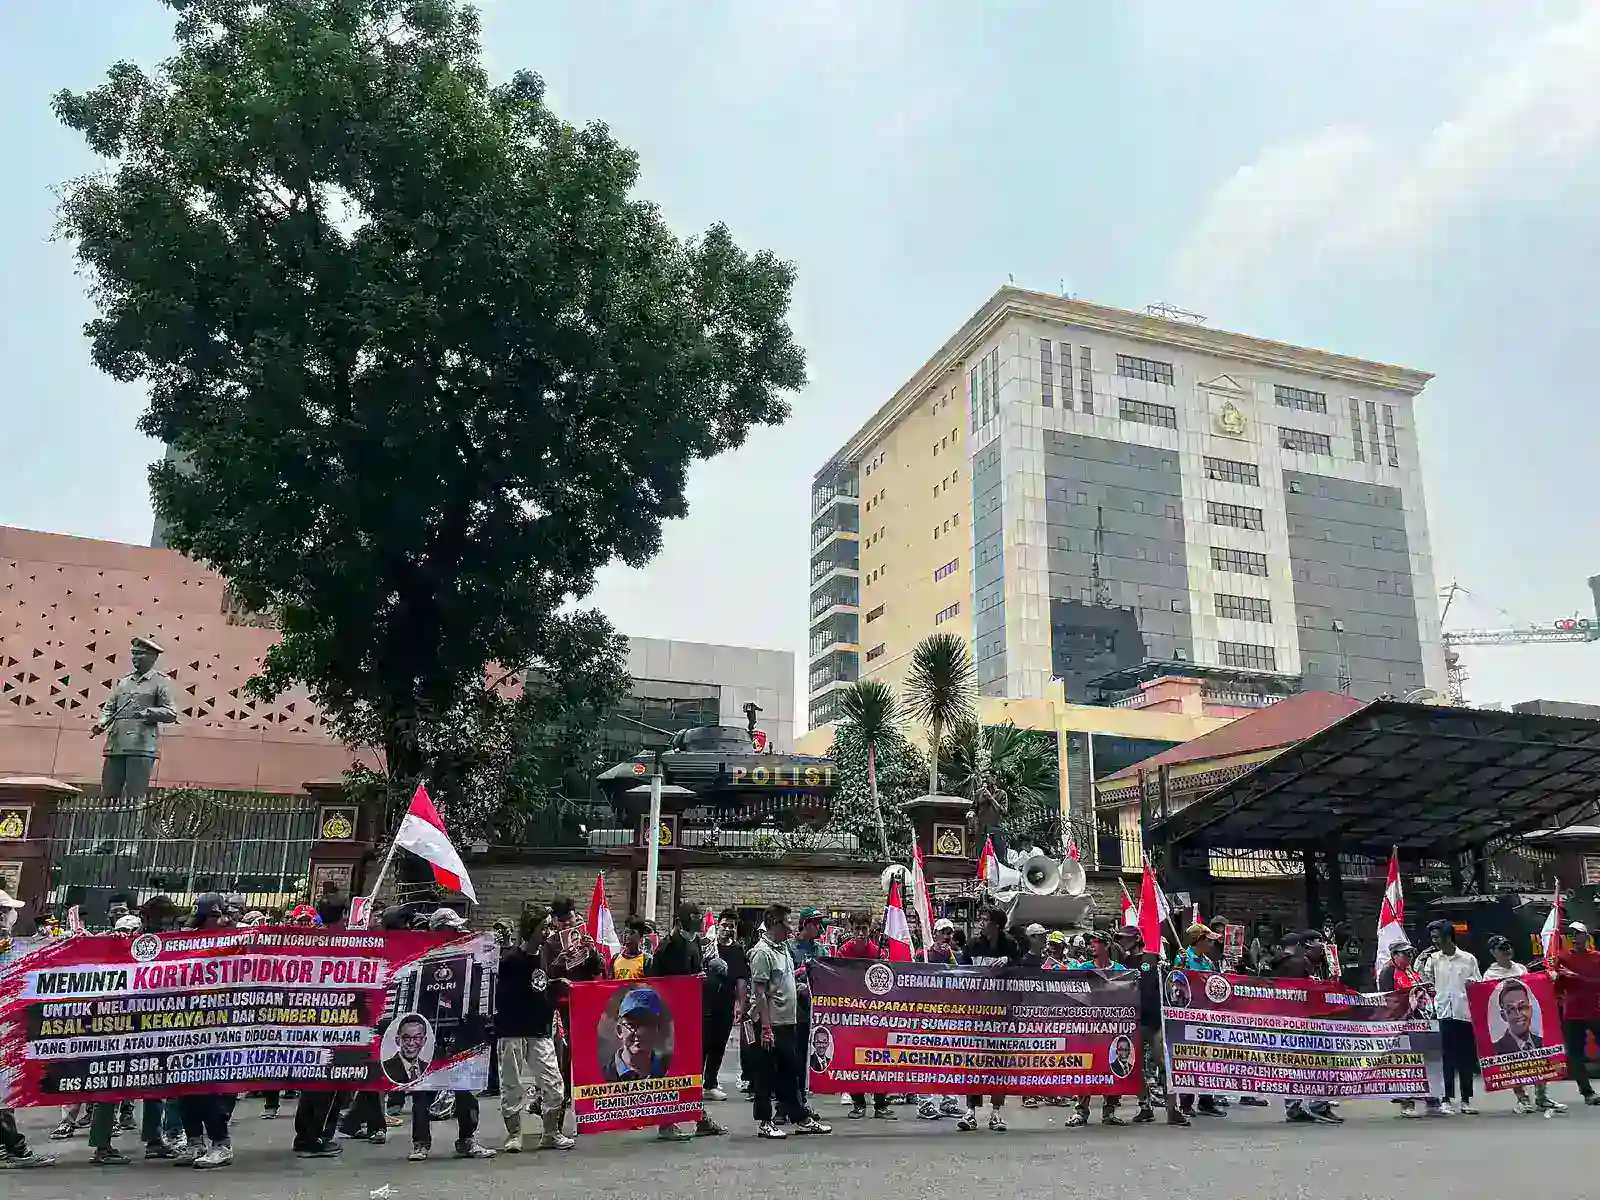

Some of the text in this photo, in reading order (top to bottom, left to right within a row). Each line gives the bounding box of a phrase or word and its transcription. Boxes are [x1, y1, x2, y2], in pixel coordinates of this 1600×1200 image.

[732, 766, 832, 786] POLISI
[165, 937, 214, 951] GERAKAN
[216, 933, 256, 948] RAKYAT
[257, 933, 282, 947] ANTI
[283, 934, 329, 947] KORUPSI
[330, 935, 385, 948] INDONESIA
[36, 958, 379, 994] MEMINTA KORTASTIPIDKOR POLRI
[897, 974, 1092, 994] GERAKAN RAKYAT ANTI KORUPSI INDONESIA
[426, 982, 457, 992] POLRI
[42, 992, 356, 1018] UNTUK MELAKUKAN PENELUSURAN TERHADAP
[868, 999, 916, 1013] APARAT
[917, 1002, 967, 1014] PENEGAK
[968, 1003, 1007, 1016] HUKUM
[1012, 1005, 1048, 1018] UNTUK
[1099, 1006, 1136, 1018] TUNTAS
[40, 1008, 359, 1036] ASAL-USUL KEKAYAAN DAN SUMBER DANA
[842, 1013, 920, 1030] MENGAUDIT
[921, 1018, 973, 1032] SUMBER
[974, 1020, 1016, 1034] HARTA
[1017, 1021, 1044, 1033] DAN
[1044, 1022, 1118, 1034] KEPEMILIKAN
[1118, 1022, 1137, 1034] IUP
[1163, 1008, 1208, 1021] MENDESAK
[1210, 1012, 1283, 1028] KORTASTIPIDKOR
[1283, 1019, 1308, 1030] POLRI
[34, 1029, 361, 1056] YANG DIMILIKI ATAU DIKUASAI YANG DIDUGA TIDAK WAJAR
[896, 1034, 1057, 1050] PT GENBA MULTI MINERAL OLEH
[1196, 1027, 1225, 1042] SDR.
[1228, 1030, 1277, 1046] ACHMAD
[1280, 1034, 1334, 1051] KURNIADI
[1336, 1038, 1351, 1050] EKS
[1353, 1039, 1374, 1051] ASN
[89, 1050, 321, 1075] OLEH SDR. ACHMAD KURNIADI
[864, 1050, 1083, 1067] SDR. ACHMAD KURNIADI EKS ASN
[1174, 1044, 1207, 1057] UNTUK
[1212, 1047, 1261, 1062] DIMINTAI
[1263, 1051, 1328, 1067] KETERANGAN
[1395, 1053, 1423, 1065] DANA
[58, 1065, 369, 1092] EKS ASN DI BADAN KOORDINASI PENANAMAN MODAL (BKPM)
[828, 1069, 1114, 1086] YANG HAMPIR LEBIH DARI 30 TAHUN BERKARIER DI BKPM
[1174, 1059, 1206, 1072] UNTUK
[1206, 1061, 1271, 1078] MEMPEROLEH
[1271, 1066, 1328, 1081] KEPEMILIKAN
[1329, 1069, 1341, 1081] PT
[1381, 1067, 1424, 1080] INVESTASI
[581, 1083, 629, 1098] MANTAN
[630, 1080, 654, 1092] ASN
[655, 1079, 666, 1090] DI
[1174, 1074, 1195, 1086] DAN
[1198, 1075, 1239, 1090] SEKITAR
[1241, 1078, 1253, 1090] 51
[1254, 1080, 1290, 1093] PERSEN
[1292, 1083, 1325, 1096] SAHAM
[1328, 1085, 1338, 1096] PT
[1364, 1082, 1387, 1094] MULTI
[1387, 1081, 1426, 1094] MINERAL
[594, 1091, 679, 1110] PEMILIK SAHAM
[581, 1108, 635, 1123] PERUSAHAAN
[636, 1102, 704, 1117] PERTAMBANGAN
